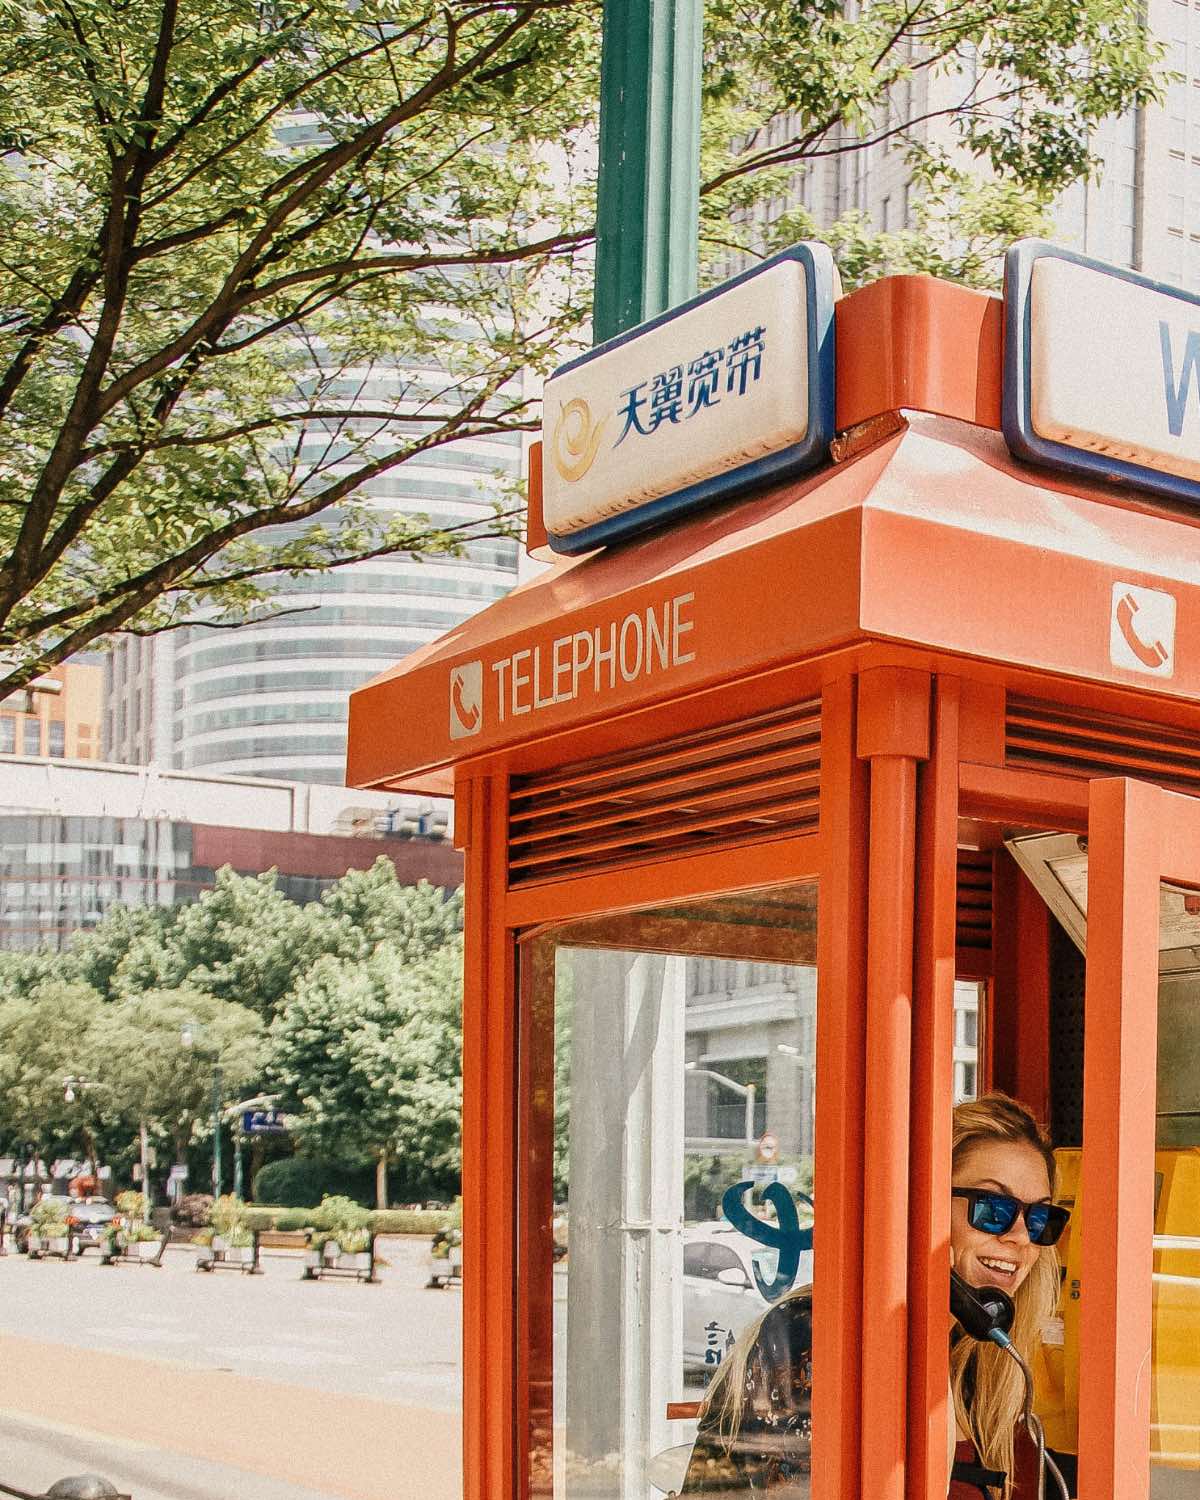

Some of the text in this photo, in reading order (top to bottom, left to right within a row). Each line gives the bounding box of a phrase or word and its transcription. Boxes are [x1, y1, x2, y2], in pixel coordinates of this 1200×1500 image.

[612, 326, 766, 448] 天翼宽带
[492, 591, 696, 722] TELEPHONE
